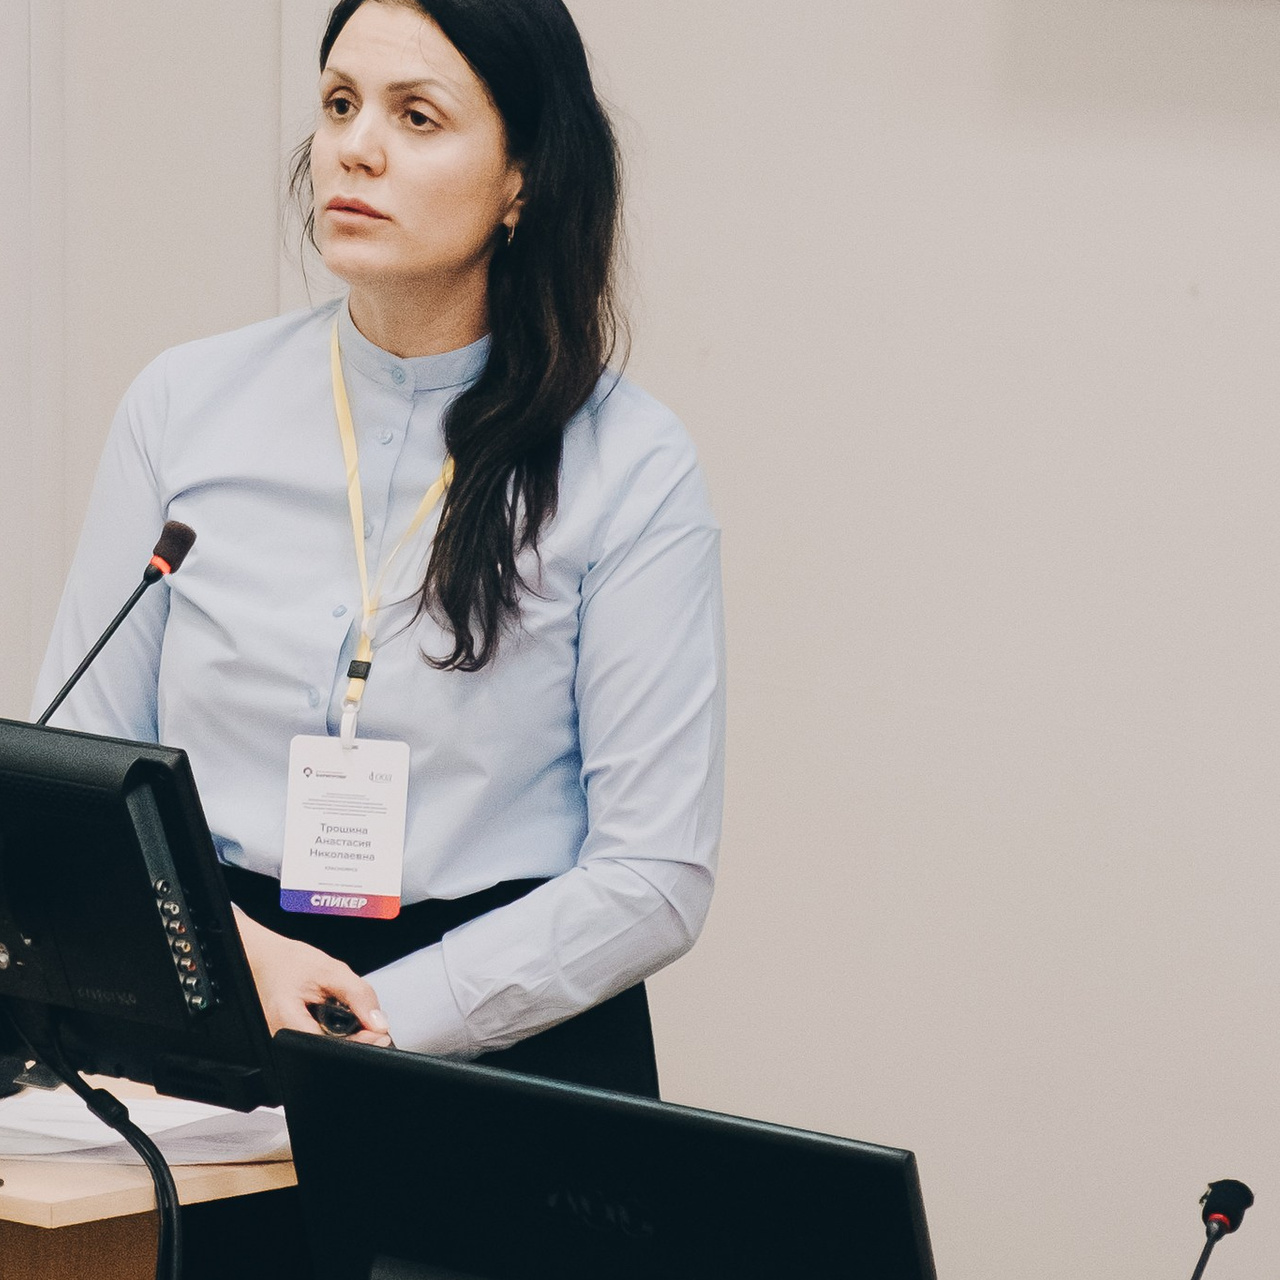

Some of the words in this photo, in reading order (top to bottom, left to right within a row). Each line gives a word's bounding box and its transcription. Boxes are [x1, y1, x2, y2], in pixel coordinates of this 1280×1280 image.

[315, 836, 371, 848] Анастасия
[310, 849, 375, 861] Николаевна
[310, 895, 368, 909] СПИКЕР
